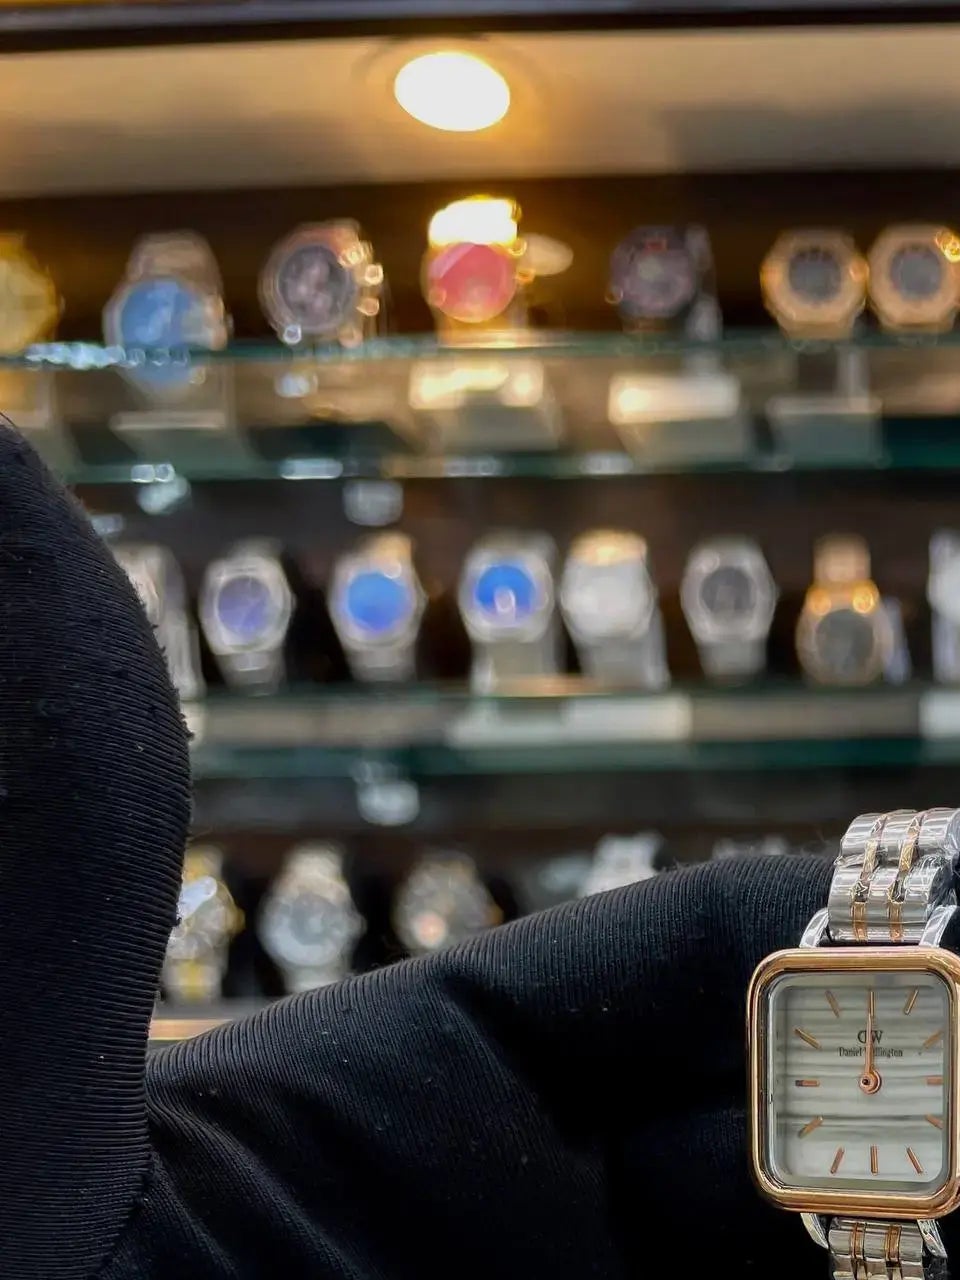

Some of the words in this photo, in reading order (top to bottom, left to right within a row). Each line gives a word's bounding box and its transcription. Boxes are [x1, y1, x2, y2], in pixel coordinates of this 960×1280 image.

[857, 1030, 884, 1044] DW
[838, 1046, 862, 1057] Daniel
[863, 1046, 904, 1059] llington
